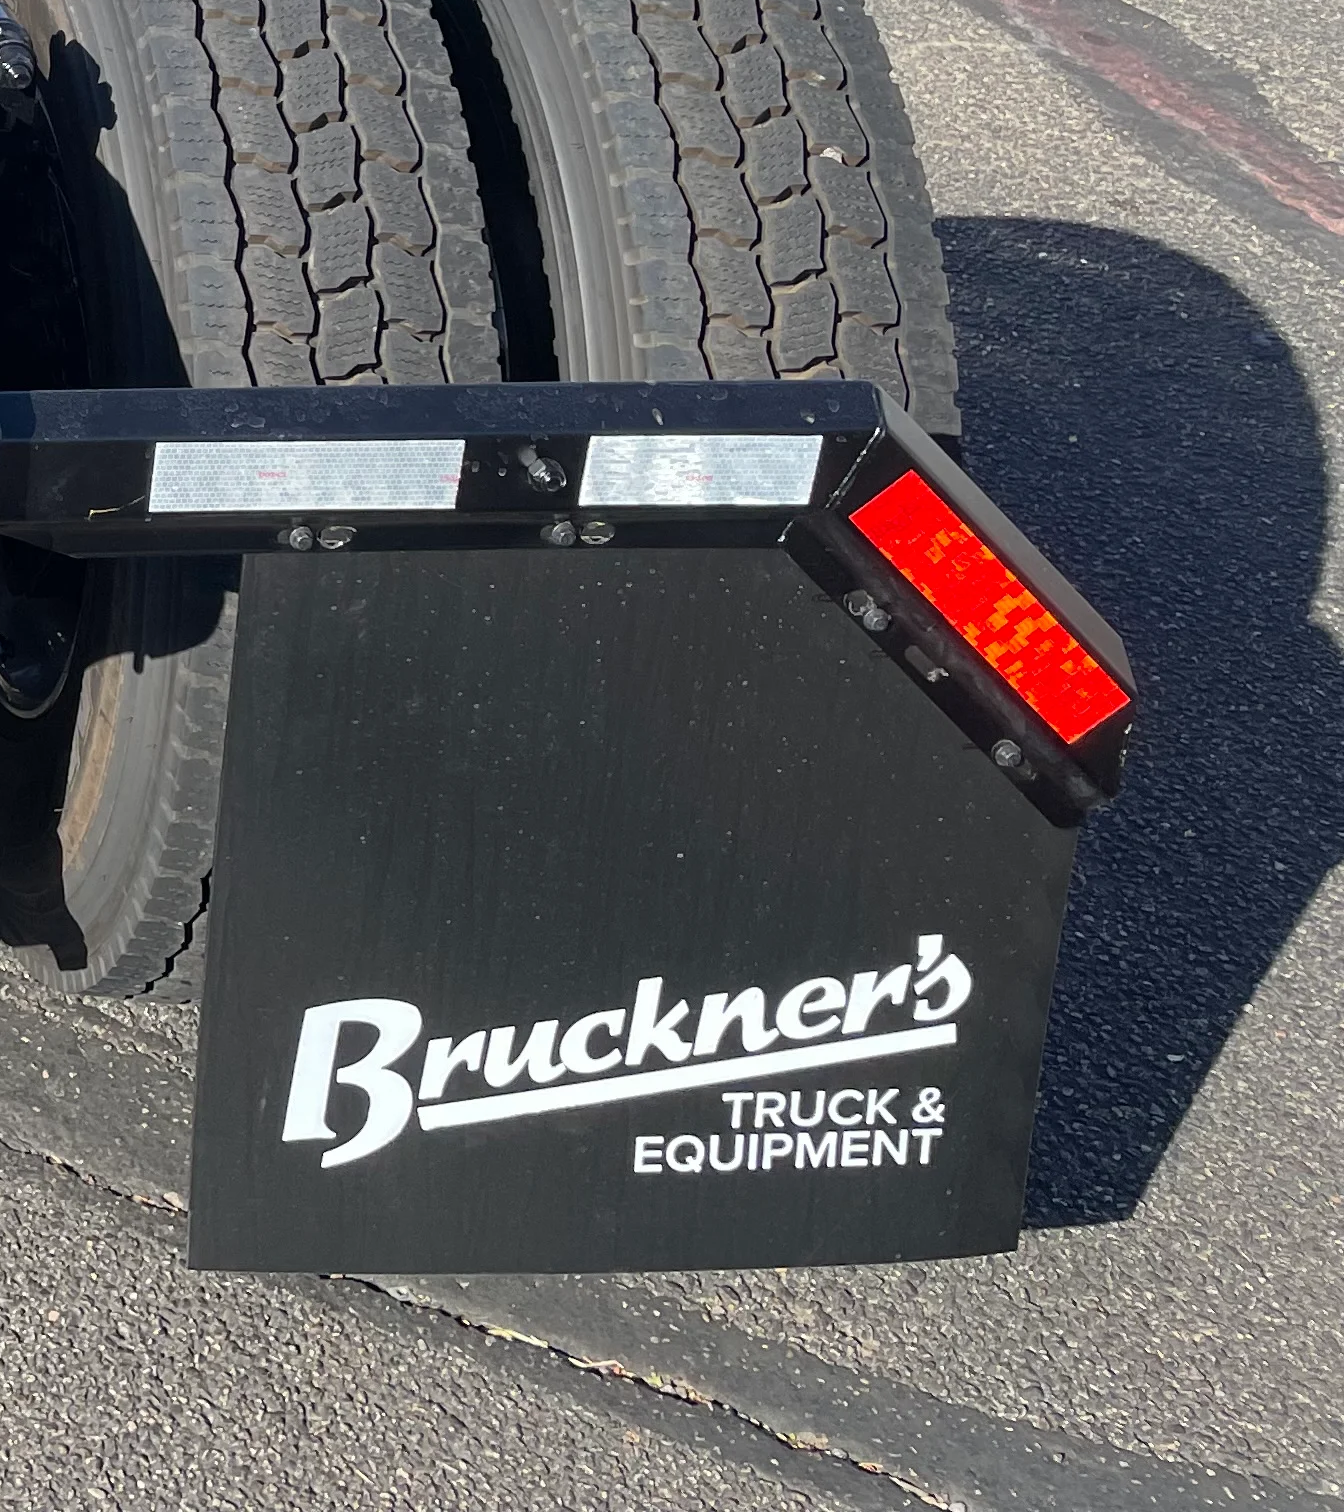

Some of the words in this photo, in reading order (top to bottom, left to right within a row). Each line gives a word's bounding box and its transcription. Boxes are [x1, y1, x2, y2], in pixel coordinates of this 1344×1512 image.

[281, 933, 972, 1169] Bruckner's
[722, 1089, 900, 1129] TRUCK
[912, 1087, 946, 1123] &
[633, 1128, 943, 1174] EQUIPMENT
